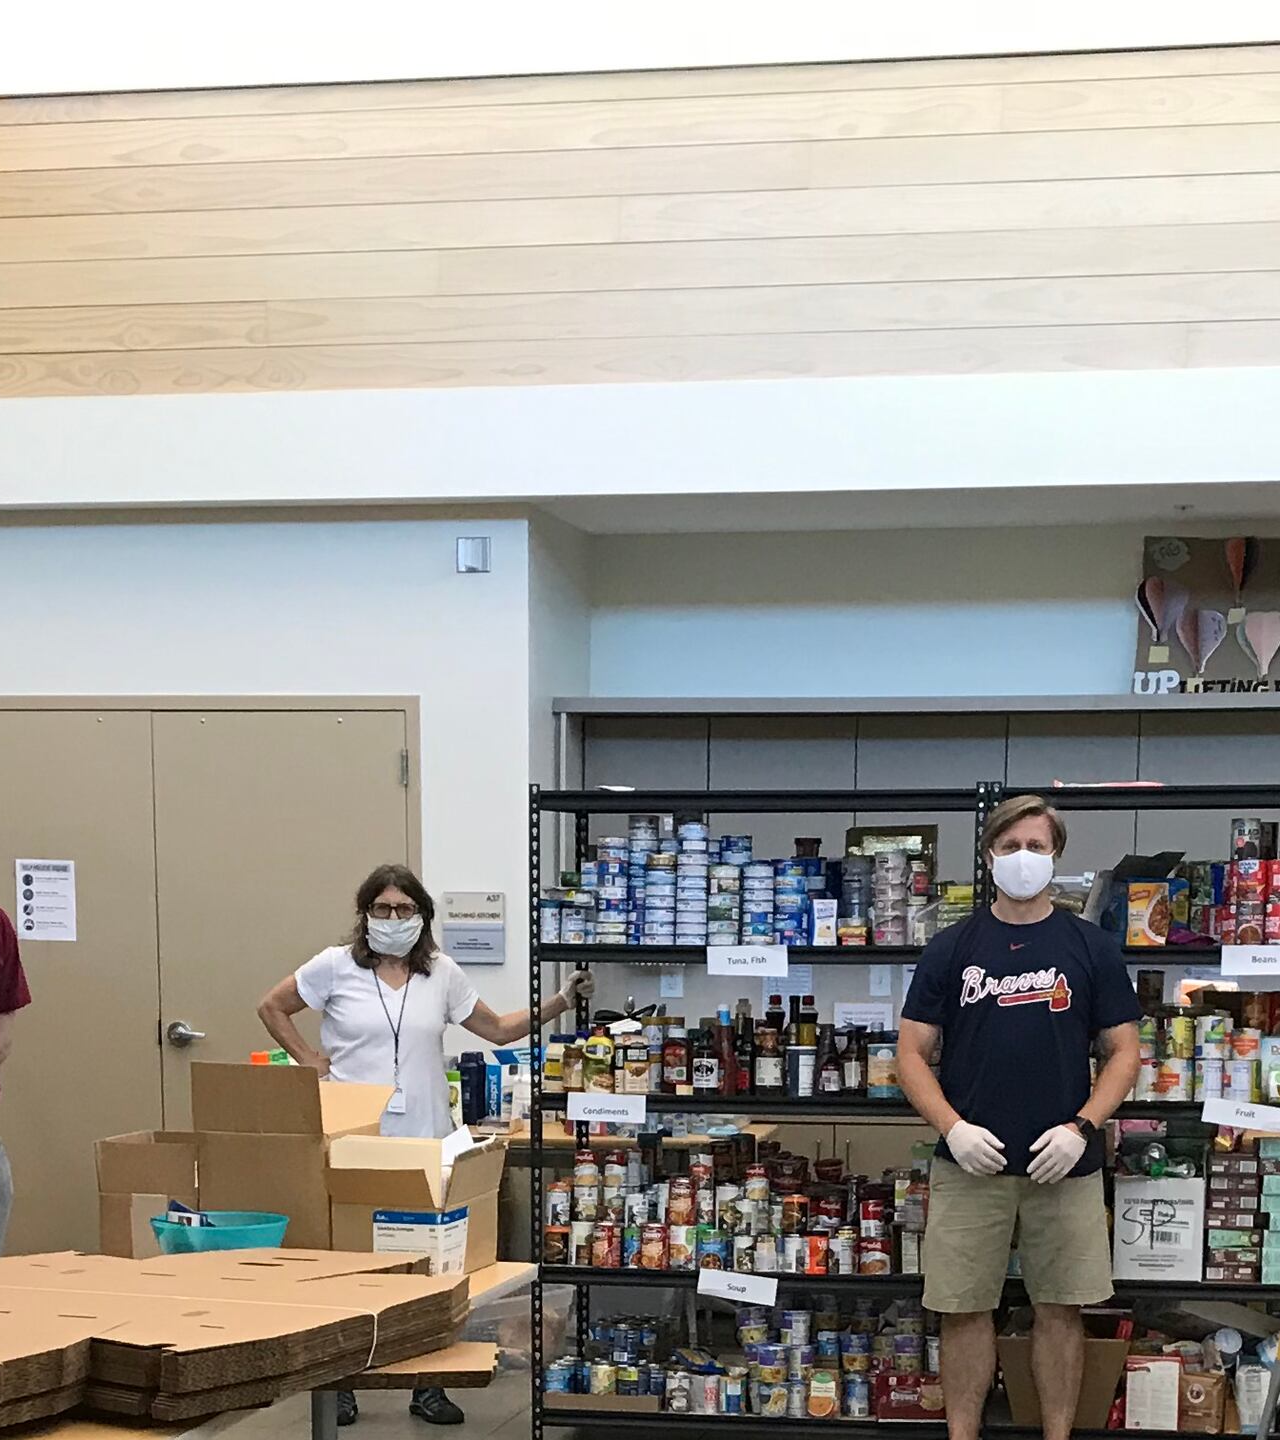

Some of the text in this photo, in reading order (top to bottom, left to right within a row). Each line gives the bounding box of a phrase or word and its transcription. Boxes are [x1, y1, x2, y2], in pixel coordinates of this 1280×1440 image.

[726, 955, 767, 967] Tuna, Fish
[1251, 956, 1278, 965] Beans
[960, 965, 1057, 1007] Braves
[582, 1106, 630, 1117] Condiments
[1235, 1107, 1256, 1119] Fruit
[726, 1283, 747, 1294] Soup
